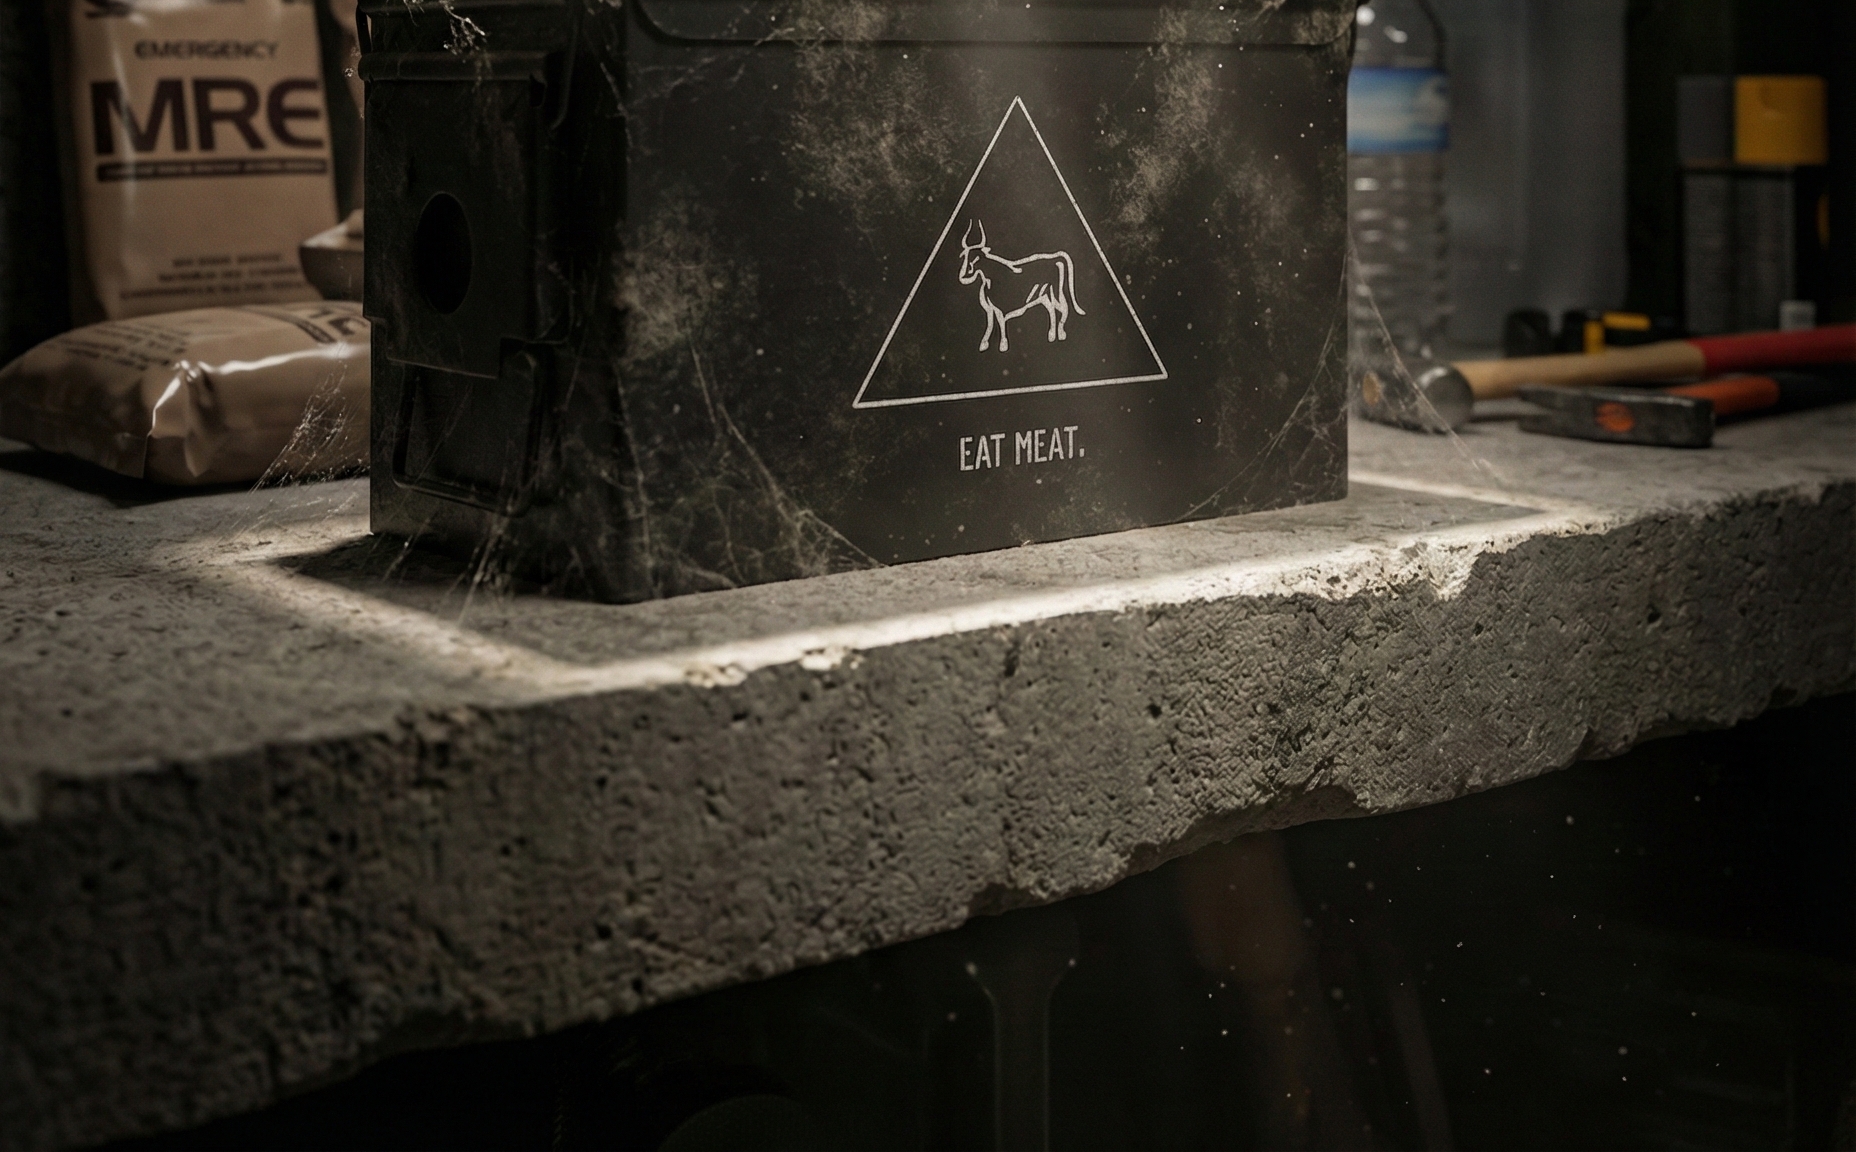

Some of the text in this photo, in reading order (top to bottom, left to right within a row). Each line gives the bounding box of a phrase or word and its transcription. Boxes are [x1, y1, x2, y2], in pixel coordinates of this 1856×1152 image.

[134, 39, 278, 60] EMERGENCY
[90, 77, 324, 155] MRE
[959, 425, 1085, 472] EAT MEAT.
